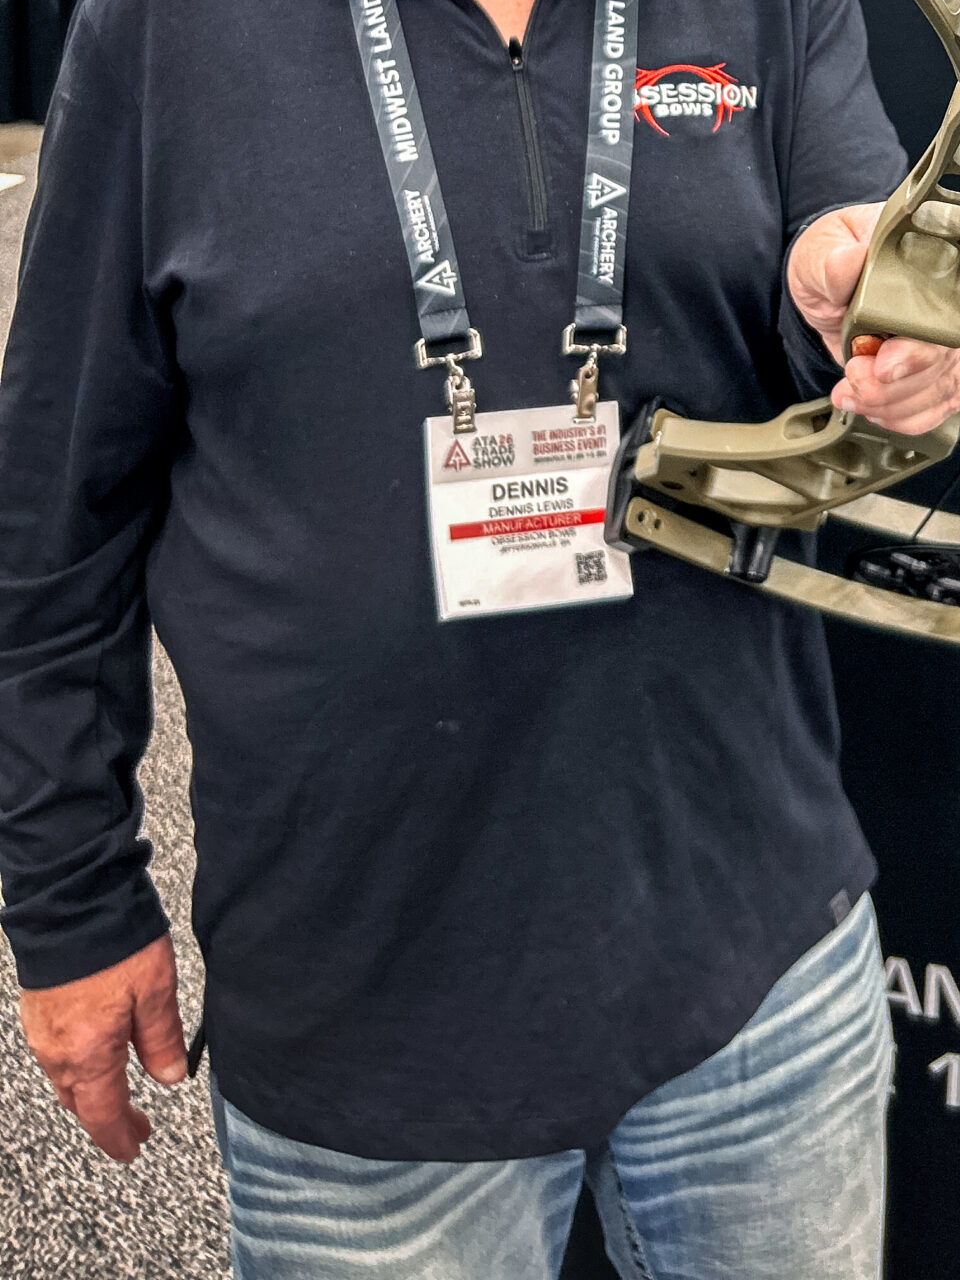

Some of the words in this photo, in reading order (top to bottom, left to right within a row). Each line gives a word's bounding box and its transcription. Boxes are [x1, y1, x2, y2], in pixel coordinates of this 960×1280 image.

[604, 1, 625, 59] LAND
[374, 59, 419, 163] MIDWEST
[598, 63, 624, 145] GROUP
[653, 102, 714, 118] BOWS
[402, 189, 436, 263] ARCHERY
[598, 206, 619, 286] ARCHERY
[473, 444, 514, 458] TRADE
[533, 440, 576, 455] BUSINESS
[473, 454, 515, 469] SHOW
[492, 476, 569, 500] DENNIS
[488, 504, 534, 518] DENNIS
[537, 498, 574, 512] LEWIS
[482, 513, 582, 534] MANUFACTURER
